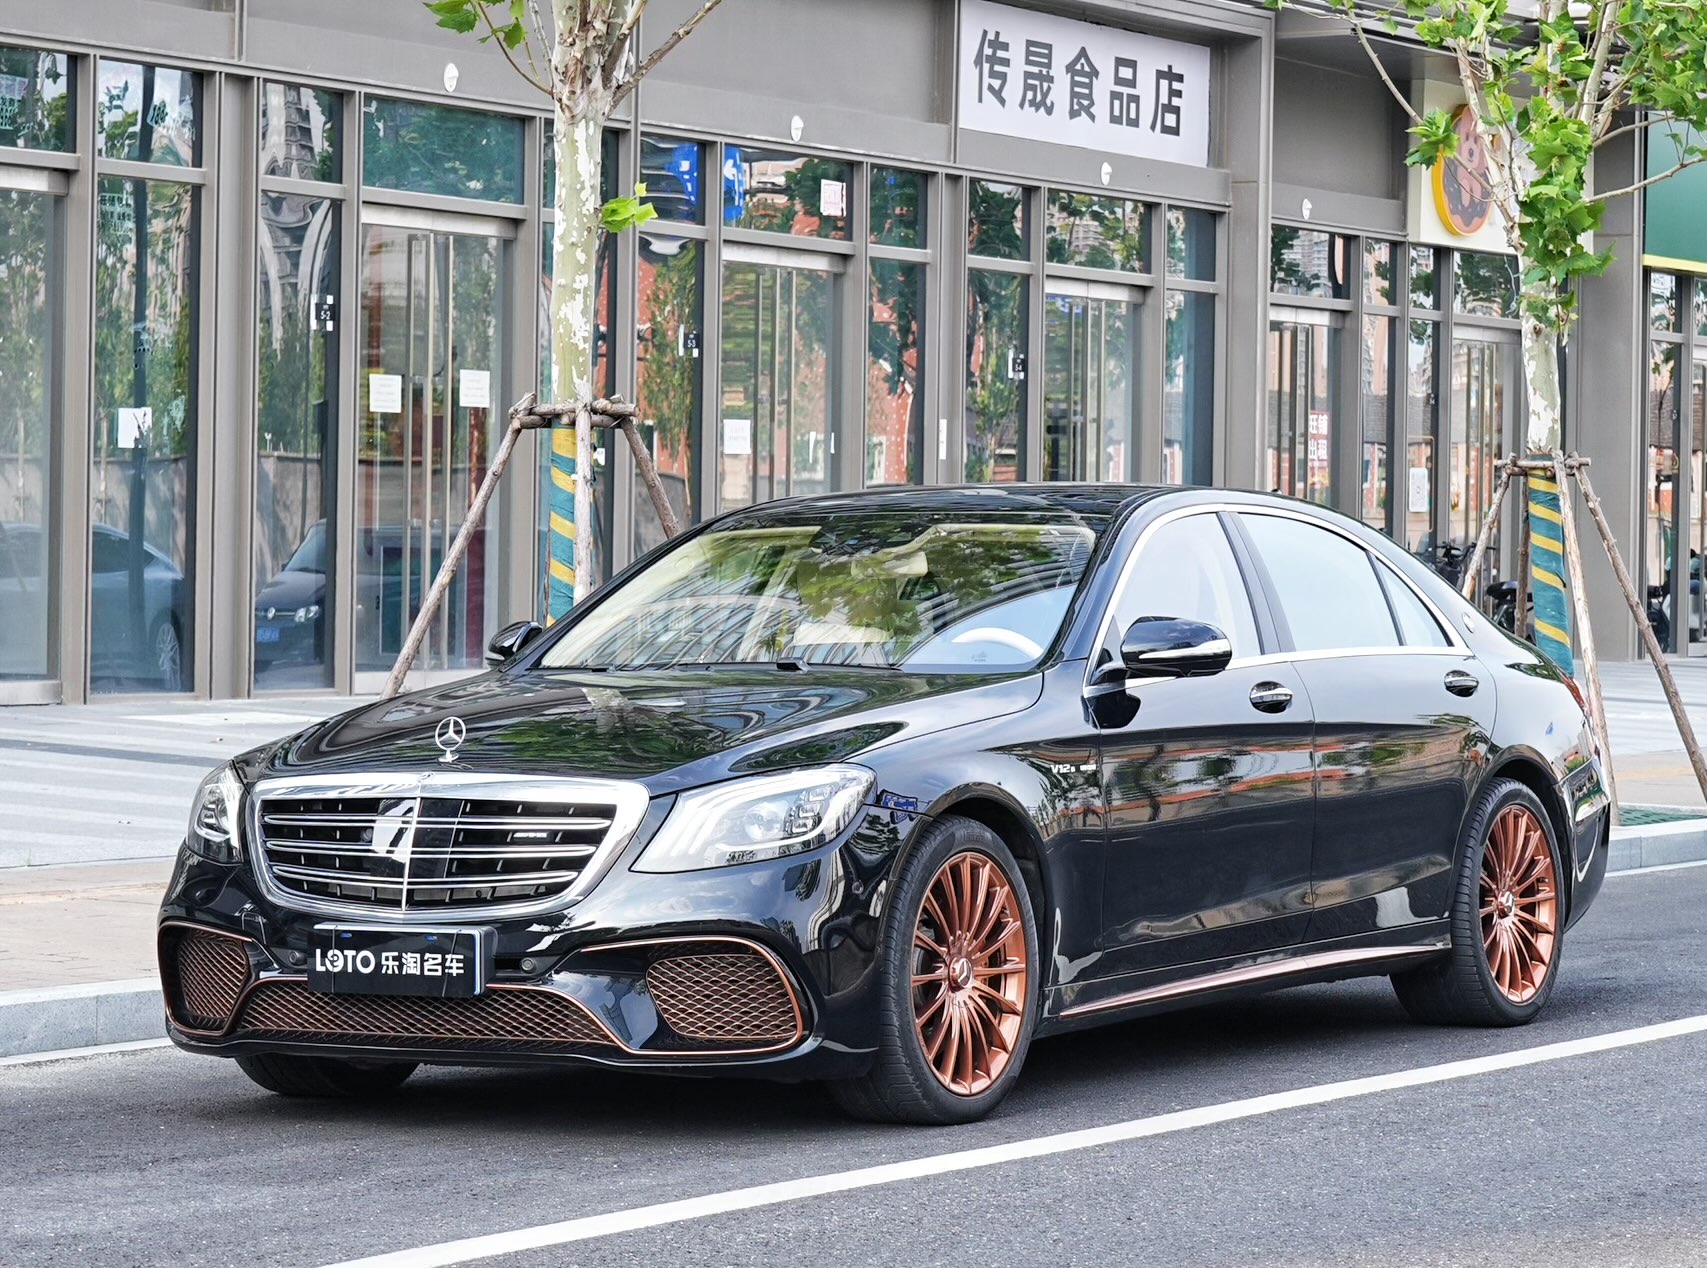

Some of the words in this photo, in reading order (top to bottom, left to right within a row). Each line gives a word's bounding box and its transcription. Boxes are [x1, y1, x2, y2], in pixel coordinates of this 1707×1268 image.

[973, 28, 1185, 137] 传晟食品店
[320, 310, 331, 320] 5-2
[381, 951, 465, 977] 乐淘名车
